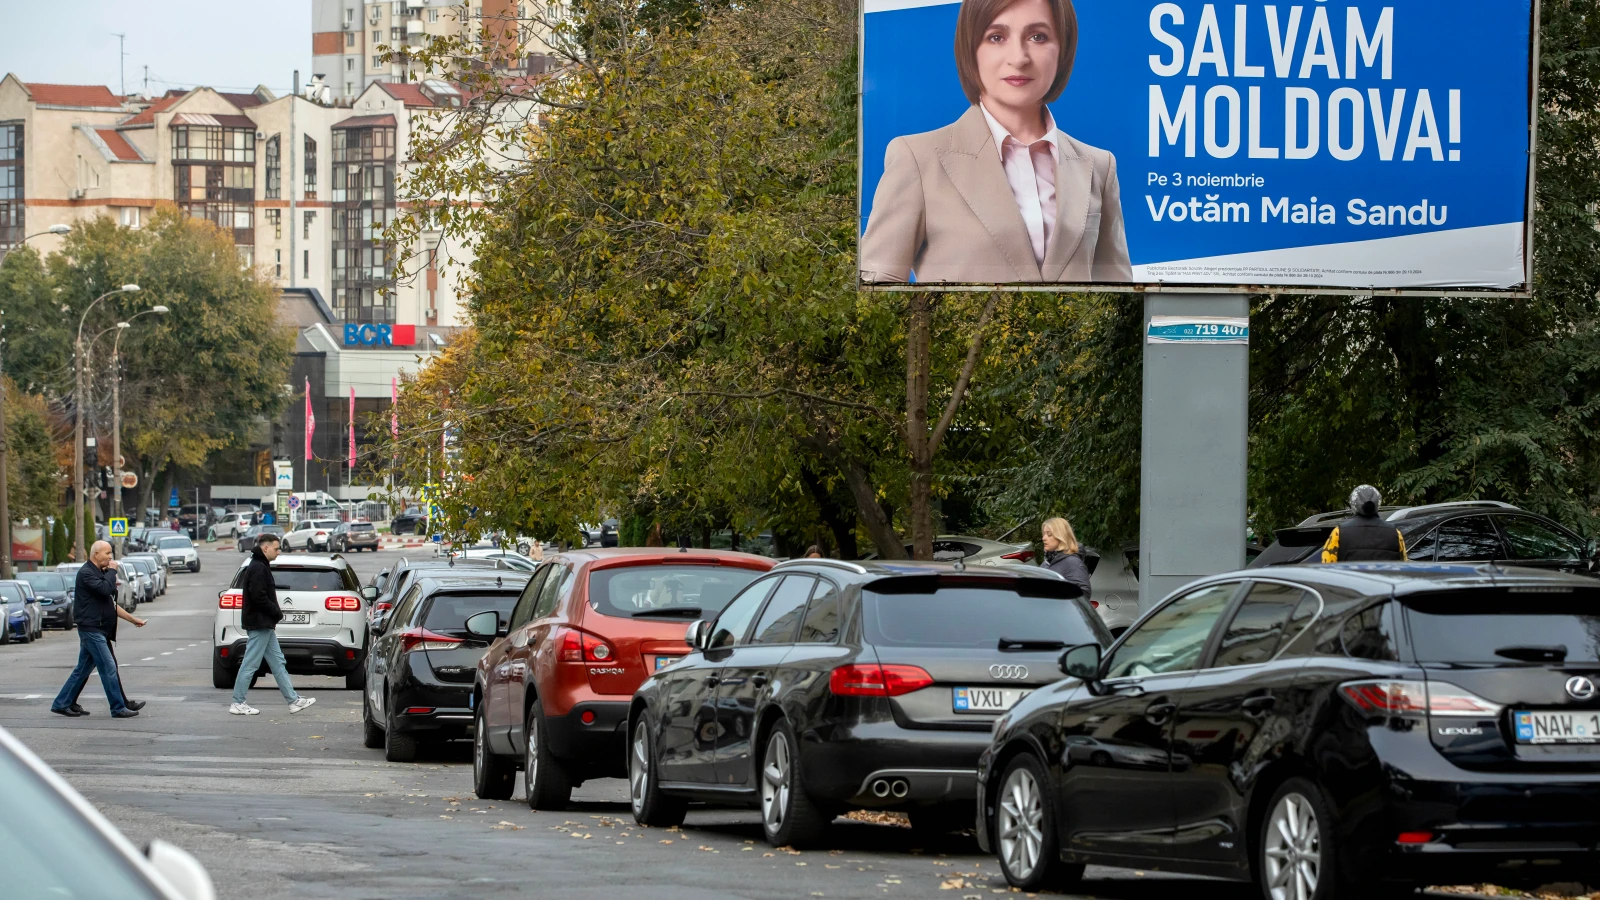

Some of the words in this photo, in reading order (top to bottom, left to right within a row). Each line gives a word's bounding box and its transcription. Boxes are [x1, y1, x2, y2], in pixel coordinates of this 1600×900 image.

[1148, 85, 1461, 162] MOLDOVA!
[1147, 172, 1168, 187] Pe
[1172, 172, 1183, 187] 3
[1187, 173, 1265, 188] noiembrie
[1146, 194, 1250, 223] Votăm
[1261, 197, 1336, 225] Maia
[1347, 199, 1448, 227] Sandu
[344, 323, 393, 346] BCR
[1194, 324, 1218, 335] 719
[292, 614, 306, 622] 238
[970, 690, 1003, 707] VXU
[1438, 727, 1483, 736] LEXUS
[1535, 715, 1572, 736] NAW
